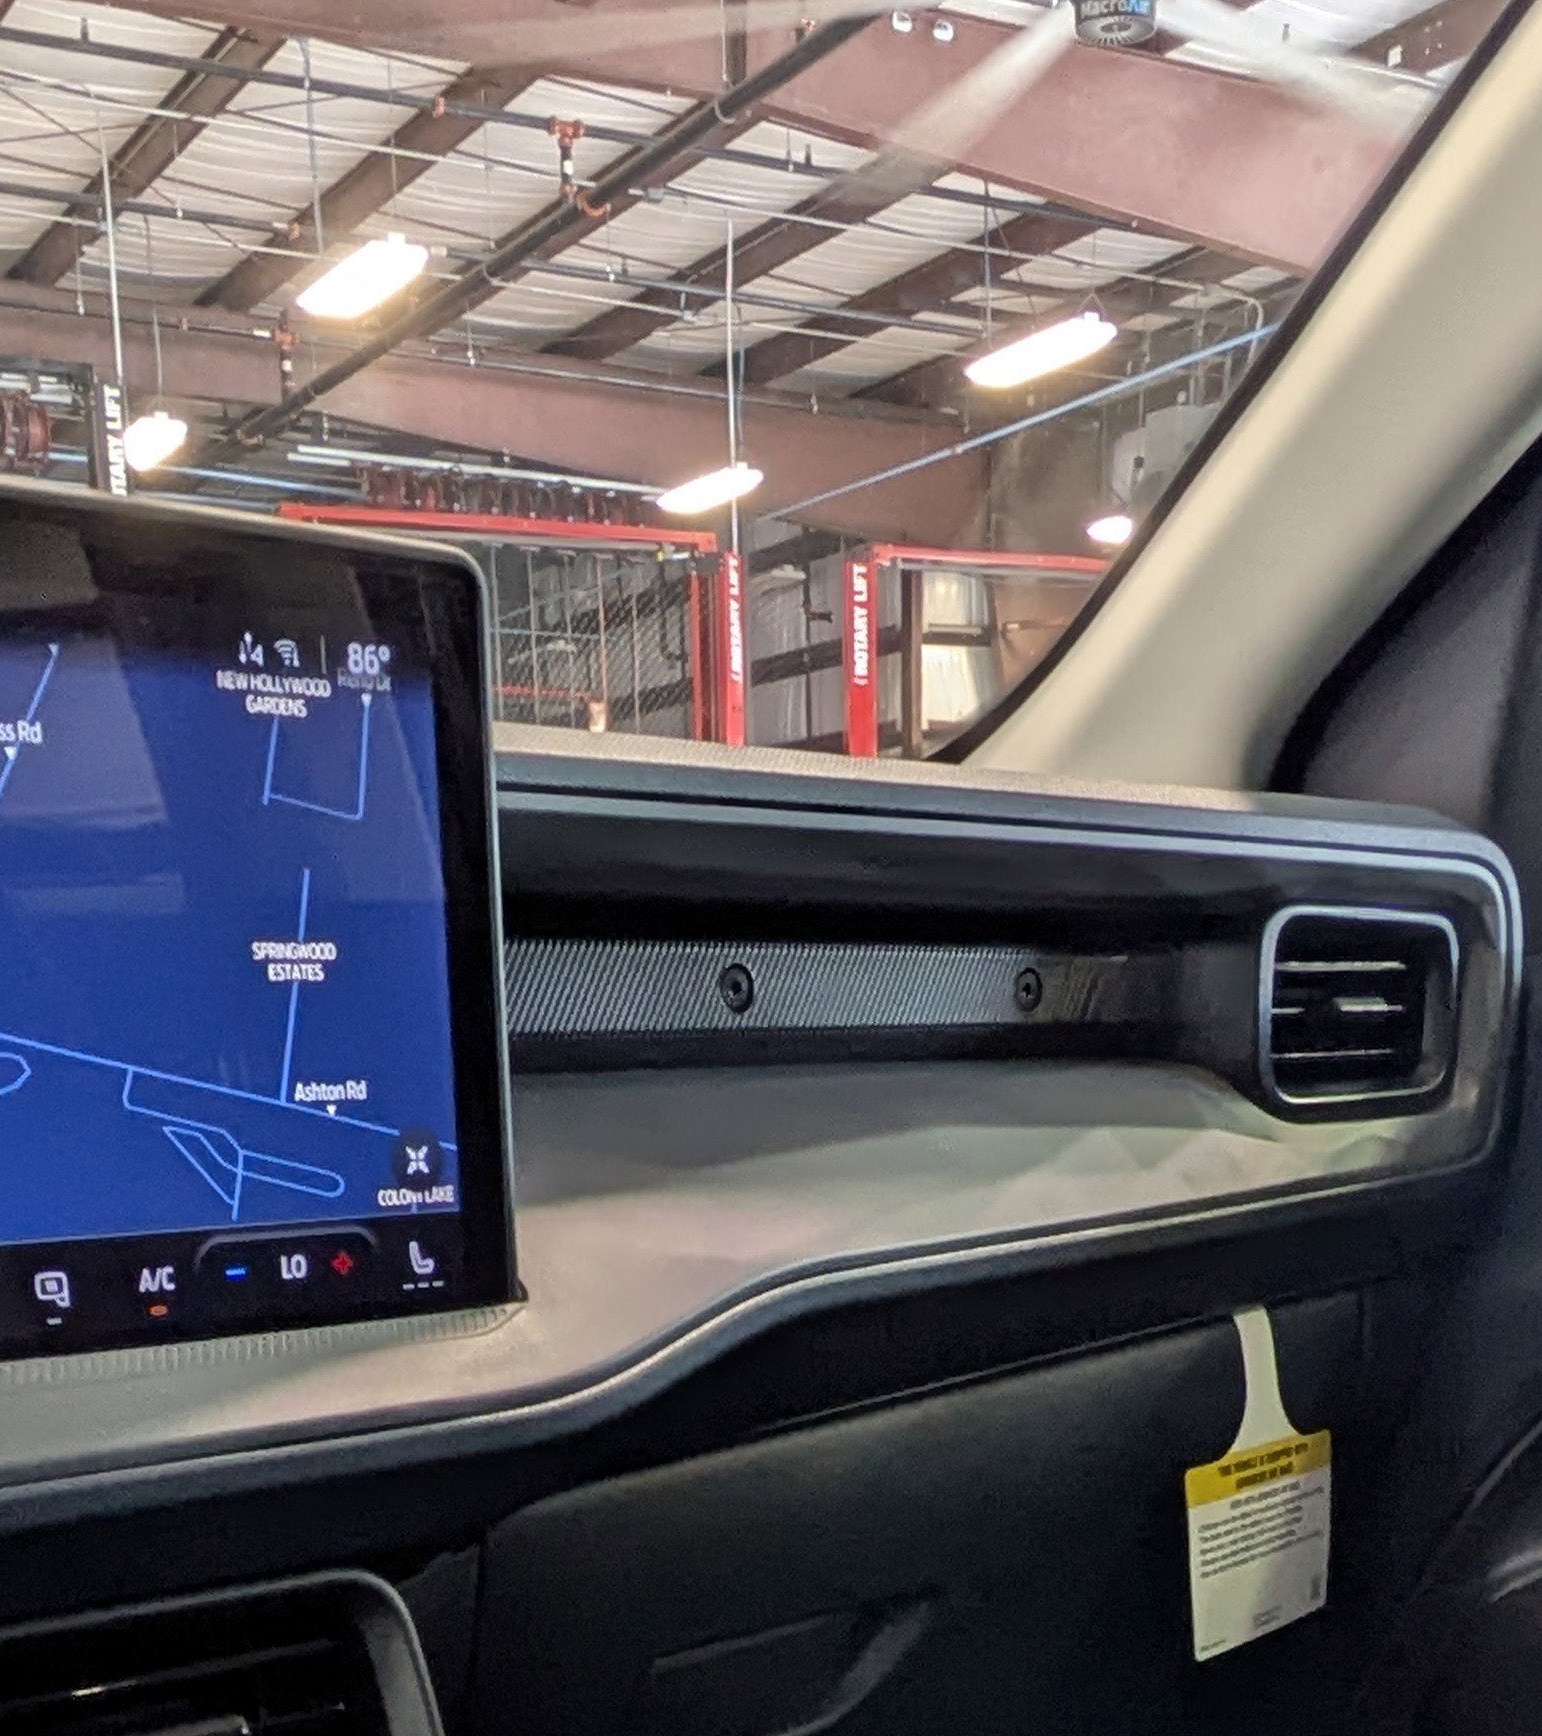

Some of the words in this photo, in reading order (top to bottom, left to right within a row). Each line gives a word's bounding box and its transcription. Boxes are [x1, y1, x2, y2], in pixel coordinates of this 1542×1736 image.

[104, 384, 122, 430] LIFT
[853, 563, 868, 602] LIFT
[853, 606, 869, 677] ROTARY
[216, 669, 248, 691] NEW
[250, 673, 332, 698] HOLLYWOOD
[245, 694, 309, 718] GARDENS
[17, 721, 43, 745] Rd
[252, 942, 337, 961] SPRINGWOOD
[267, 964, 325, 982] ESTATES
[294, 1081, 346, 1101] Ashton
[347, 1080, 368, 1100] Rd
[139, 1267, 176, 1293] A/C
[280, 1255, 308, 1281] LO
